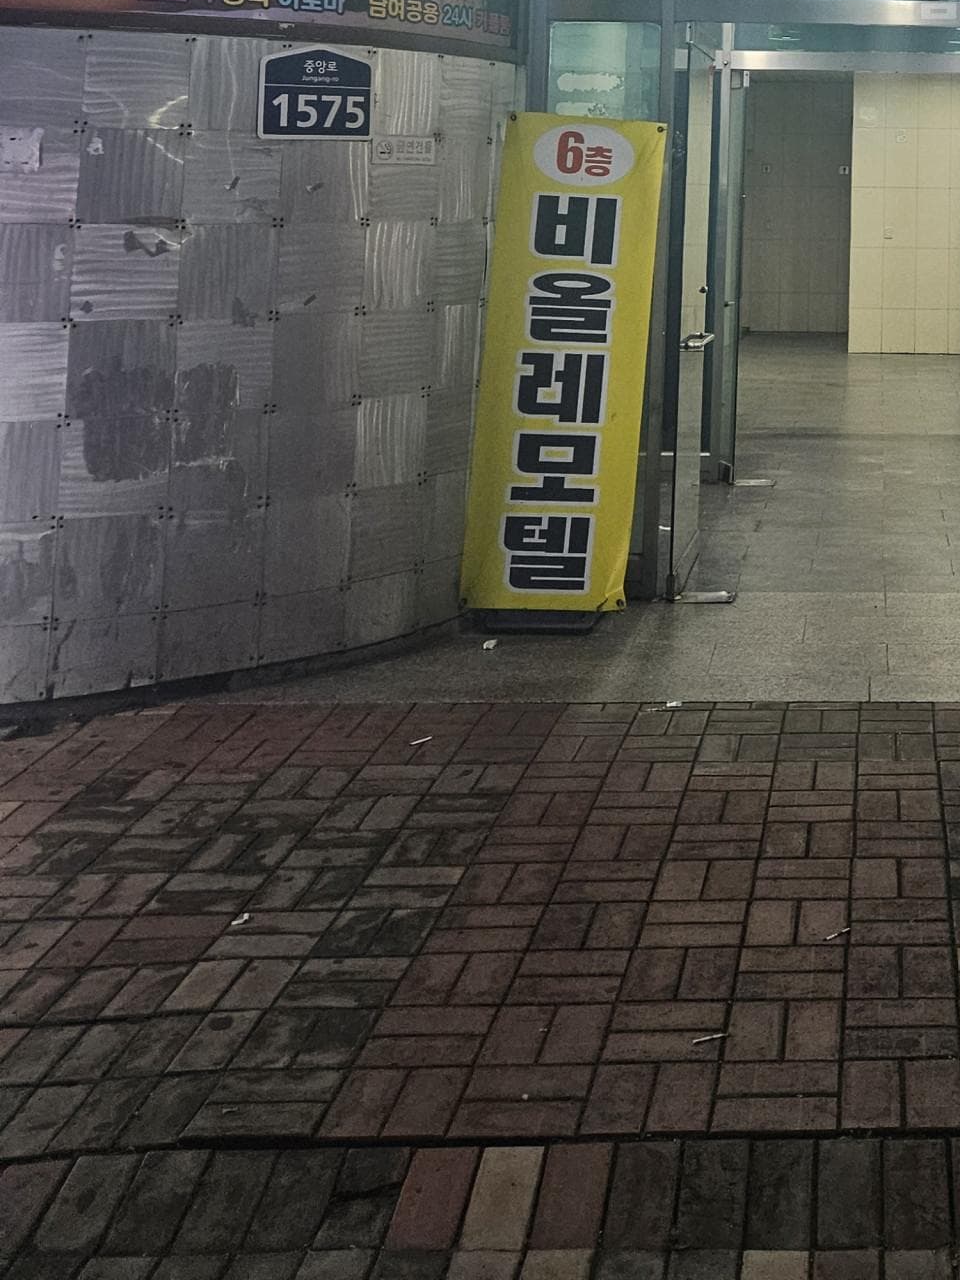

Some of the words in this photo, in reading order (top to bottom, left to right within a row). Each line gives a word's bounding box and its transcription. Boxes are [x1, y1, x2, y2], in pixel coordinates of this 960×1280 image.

[443, 6, 473, 30] 24시
[304, 60, 338, 73] 중앙로
[272, 93, 365, 128] 1575
[556, 131, 612, 177] 6층
[503, 193, 618, 591] 비올레모텔
